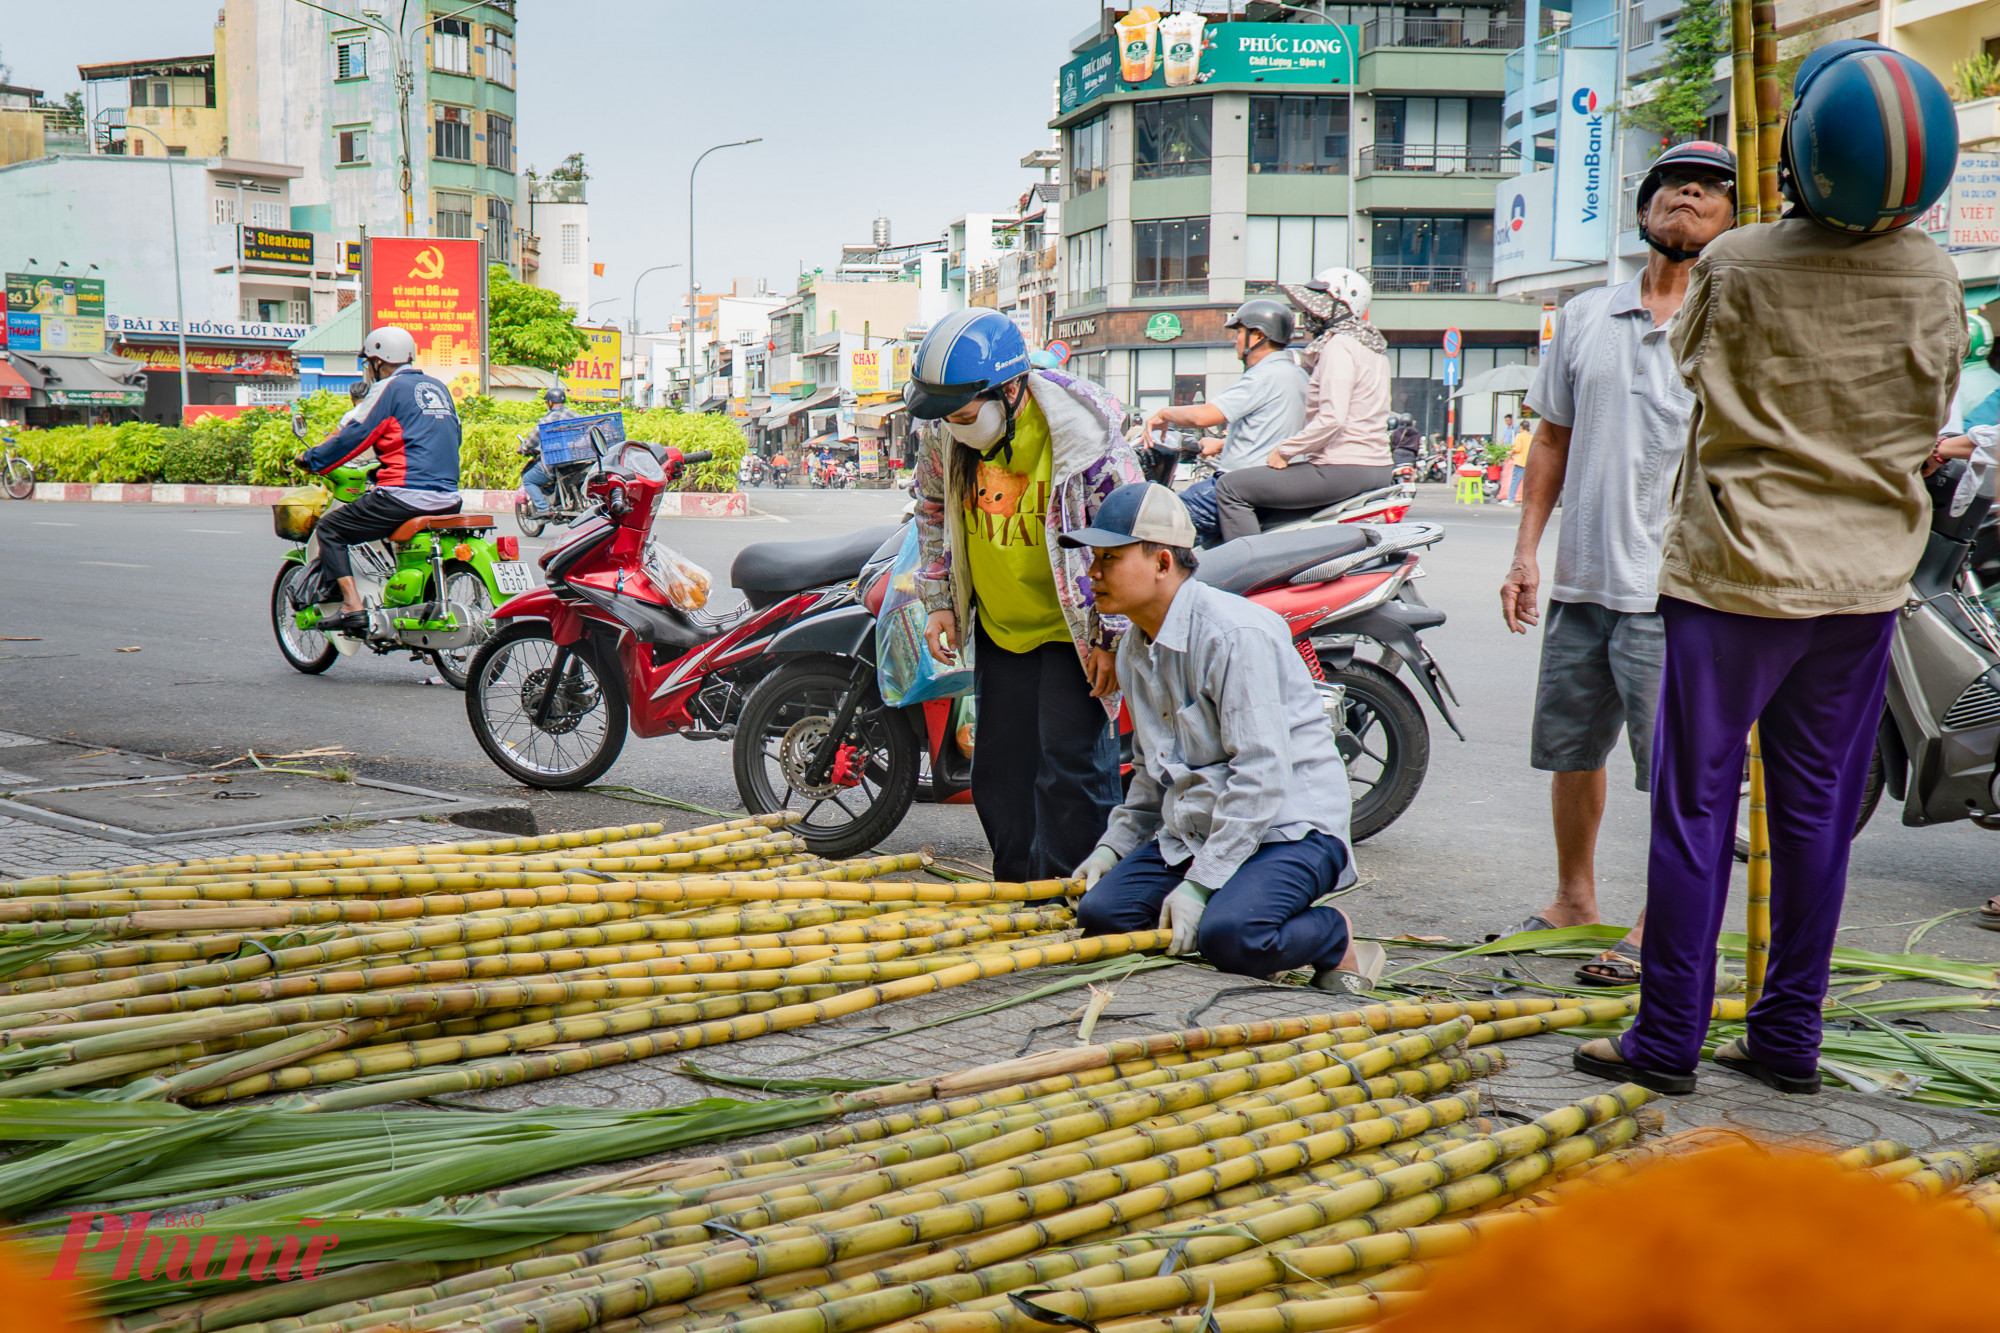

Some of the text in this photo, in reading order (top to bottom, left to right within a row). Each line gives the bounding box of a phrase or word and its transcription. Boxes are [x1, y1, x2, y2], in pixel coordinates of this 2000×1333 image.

[1238, 33, 1342, 54] PHÚC LONG
[1581, 114, 1603, 224] VietinBank
[1960, 203, 1996, 223] VIỆT
[257, 231, 311, 250] Steakzone
[1953, 224, 2000, 243] THẮNG
[425, 284, 440, 296] 96
[439, 310, 455, 322] VIỆT
[456, 312, 475, 321] NAM
[123, 316, 306, 339] BÃI XE HỒNG LỢI NAM
[429, 323, 464, 332] 3/2/2026)
[121, 346, 150, 362] Chúc
[186, 350, 213, 366] Năm
[213, 350, 237, 367] Mới
[853, 352, 878, 366] CHAY
[496, 563, 526, 577] 54-LA
[502, 577, 530, 591] 0302
